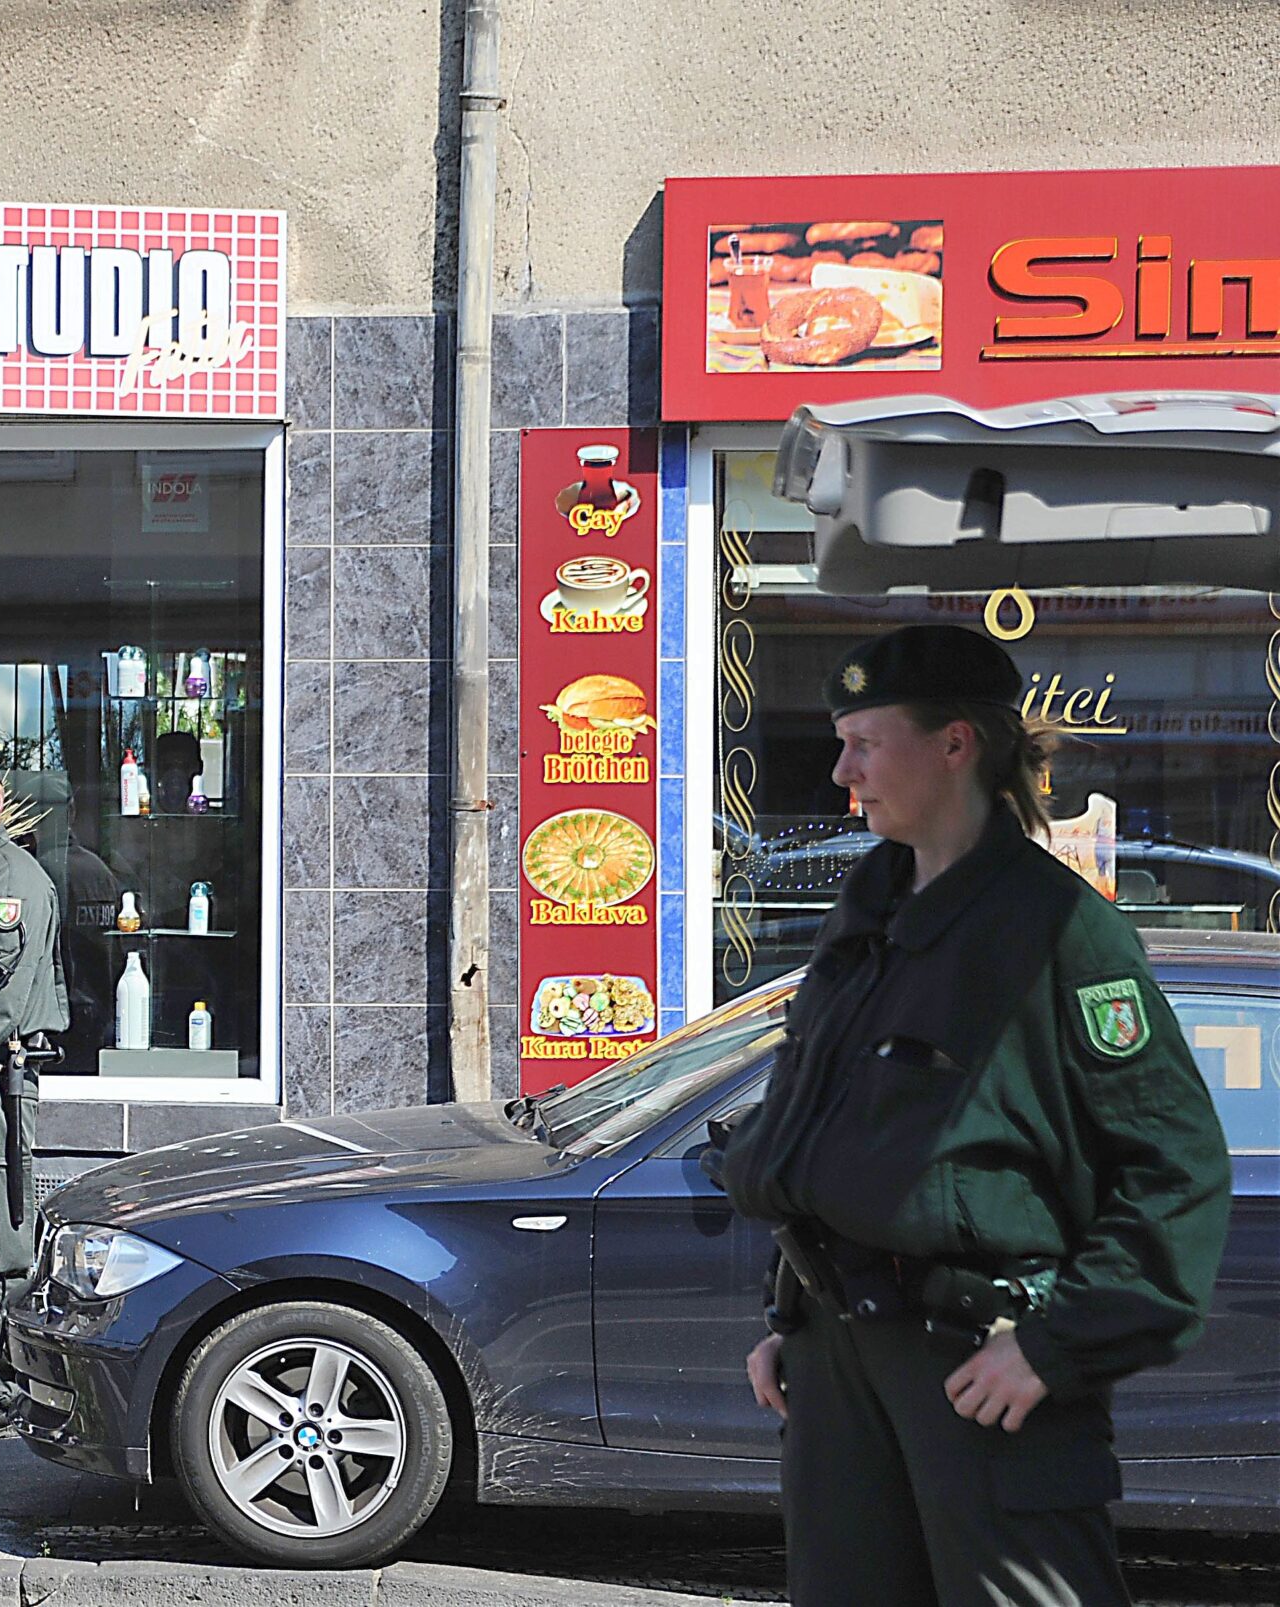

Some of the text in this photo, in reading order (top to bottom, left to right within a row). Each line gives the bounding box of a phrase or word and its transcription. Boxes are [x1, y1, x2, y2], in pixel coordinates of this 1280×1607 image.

[148, 481, 202, 495] INDOLA
[569, 504, 624, 536] Çay
[551, 609, 643, 632] Kahve
[1020, 672, 1119, 724] itci
[561, 730, 633, 754] belegte
[545, 755, 649, 782] Brötchen
[531, 901, 647, 924] Baklava
[1083, 982, 1135, 1004] POLIZEI
[522, 1037, 587, 1058] Kuru
